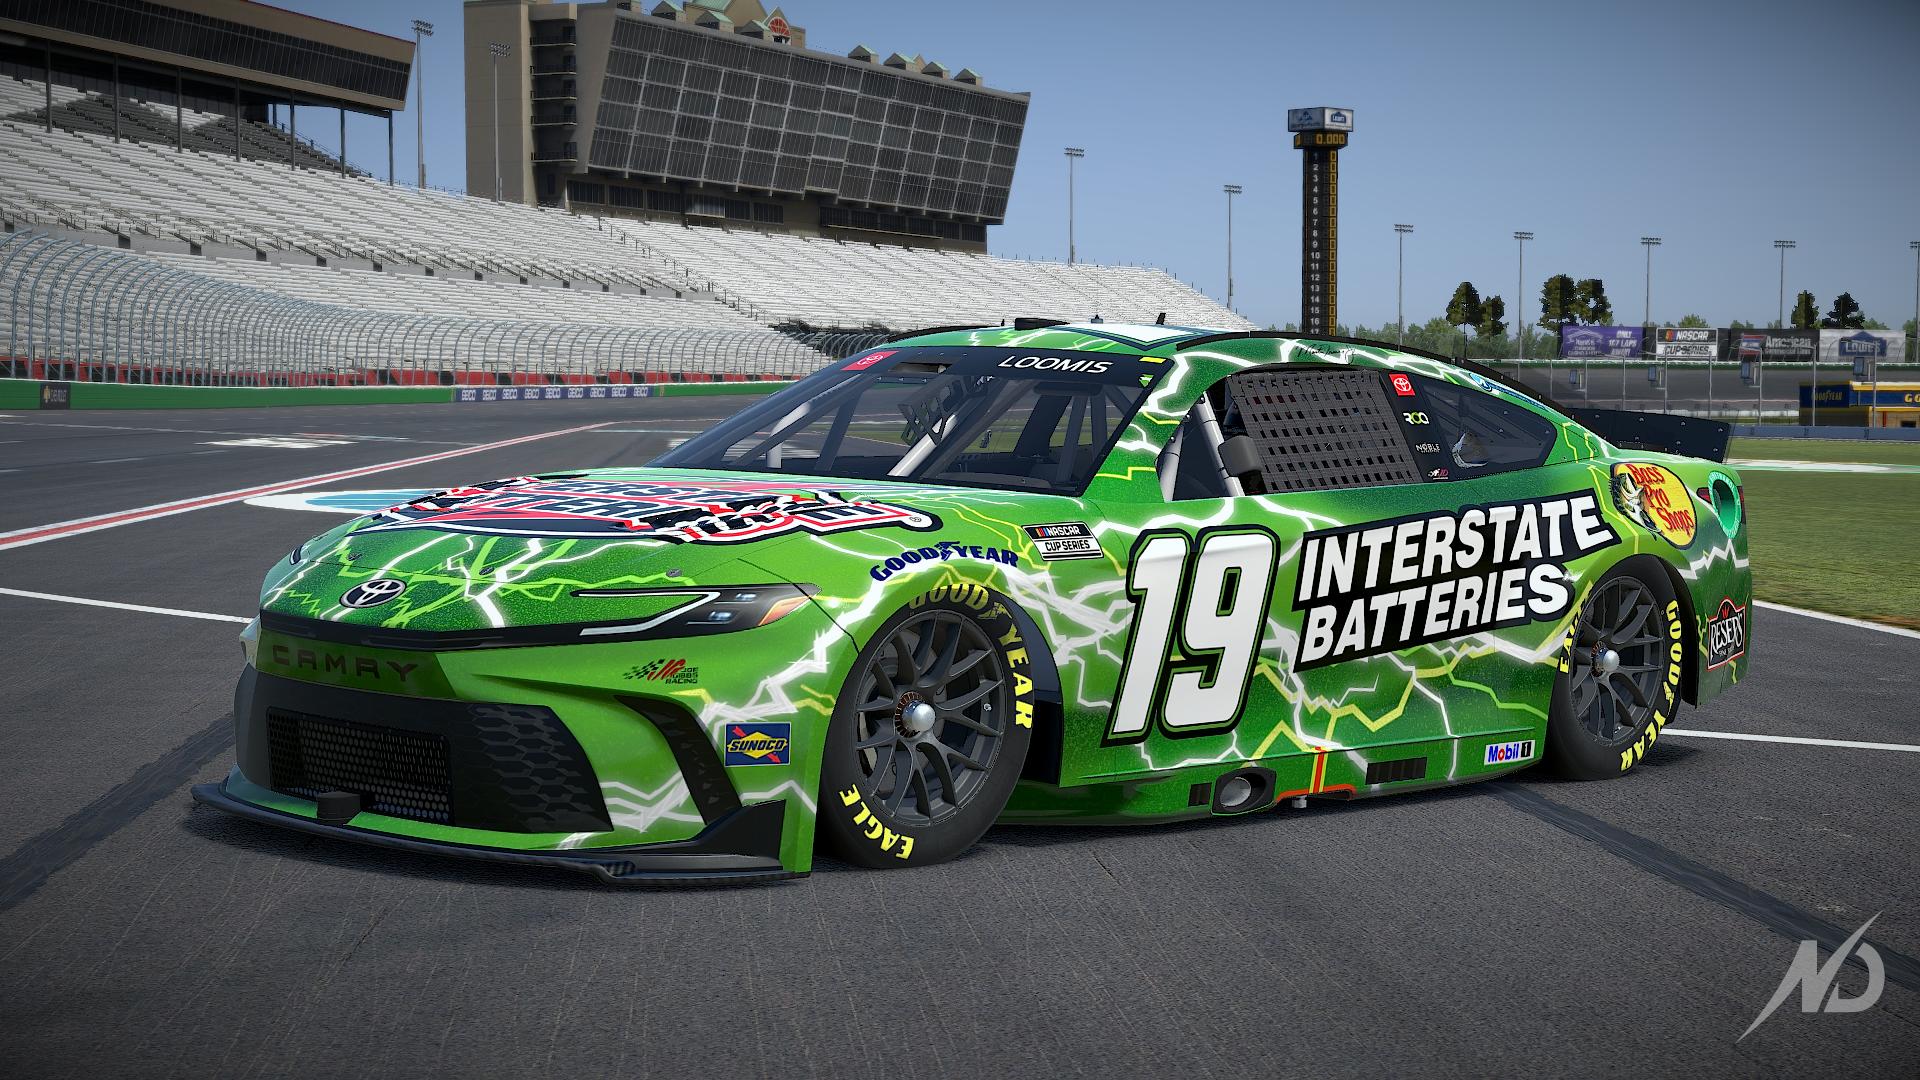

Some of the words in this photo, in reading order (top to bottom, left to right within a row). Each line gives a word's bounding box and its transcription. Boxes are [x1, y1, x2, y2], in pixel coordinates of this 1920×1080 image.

[1676, 330, 1709, 341] NASCAR
[998, 355, 1114, 374] LOOMIS
[1626, 463, 1665, 486] Bass
[1642, 483, 1672, 509] Pro
[1048, 525, 1082, 537] NASCAR
[1656, 506, 1695, 537] Shops
[1045, 541, 1062, 552] CUP
[1062, 539, 1091, 551] SERIES
[1299, 495, 1614, 602] INTERSTATE
[870, 541, 1019, 582] GOODYEAR
[1300, 563, 1569, 663] BATTERIES
[1106, 530, 1276, 741] 19
[272, 644, 419, 683] CAMRY
[730, 739, 786, 752] SUNOCO
[1487, 743, 1520, 763] Mobil
[838, 783, 915, 860] EAGLE
